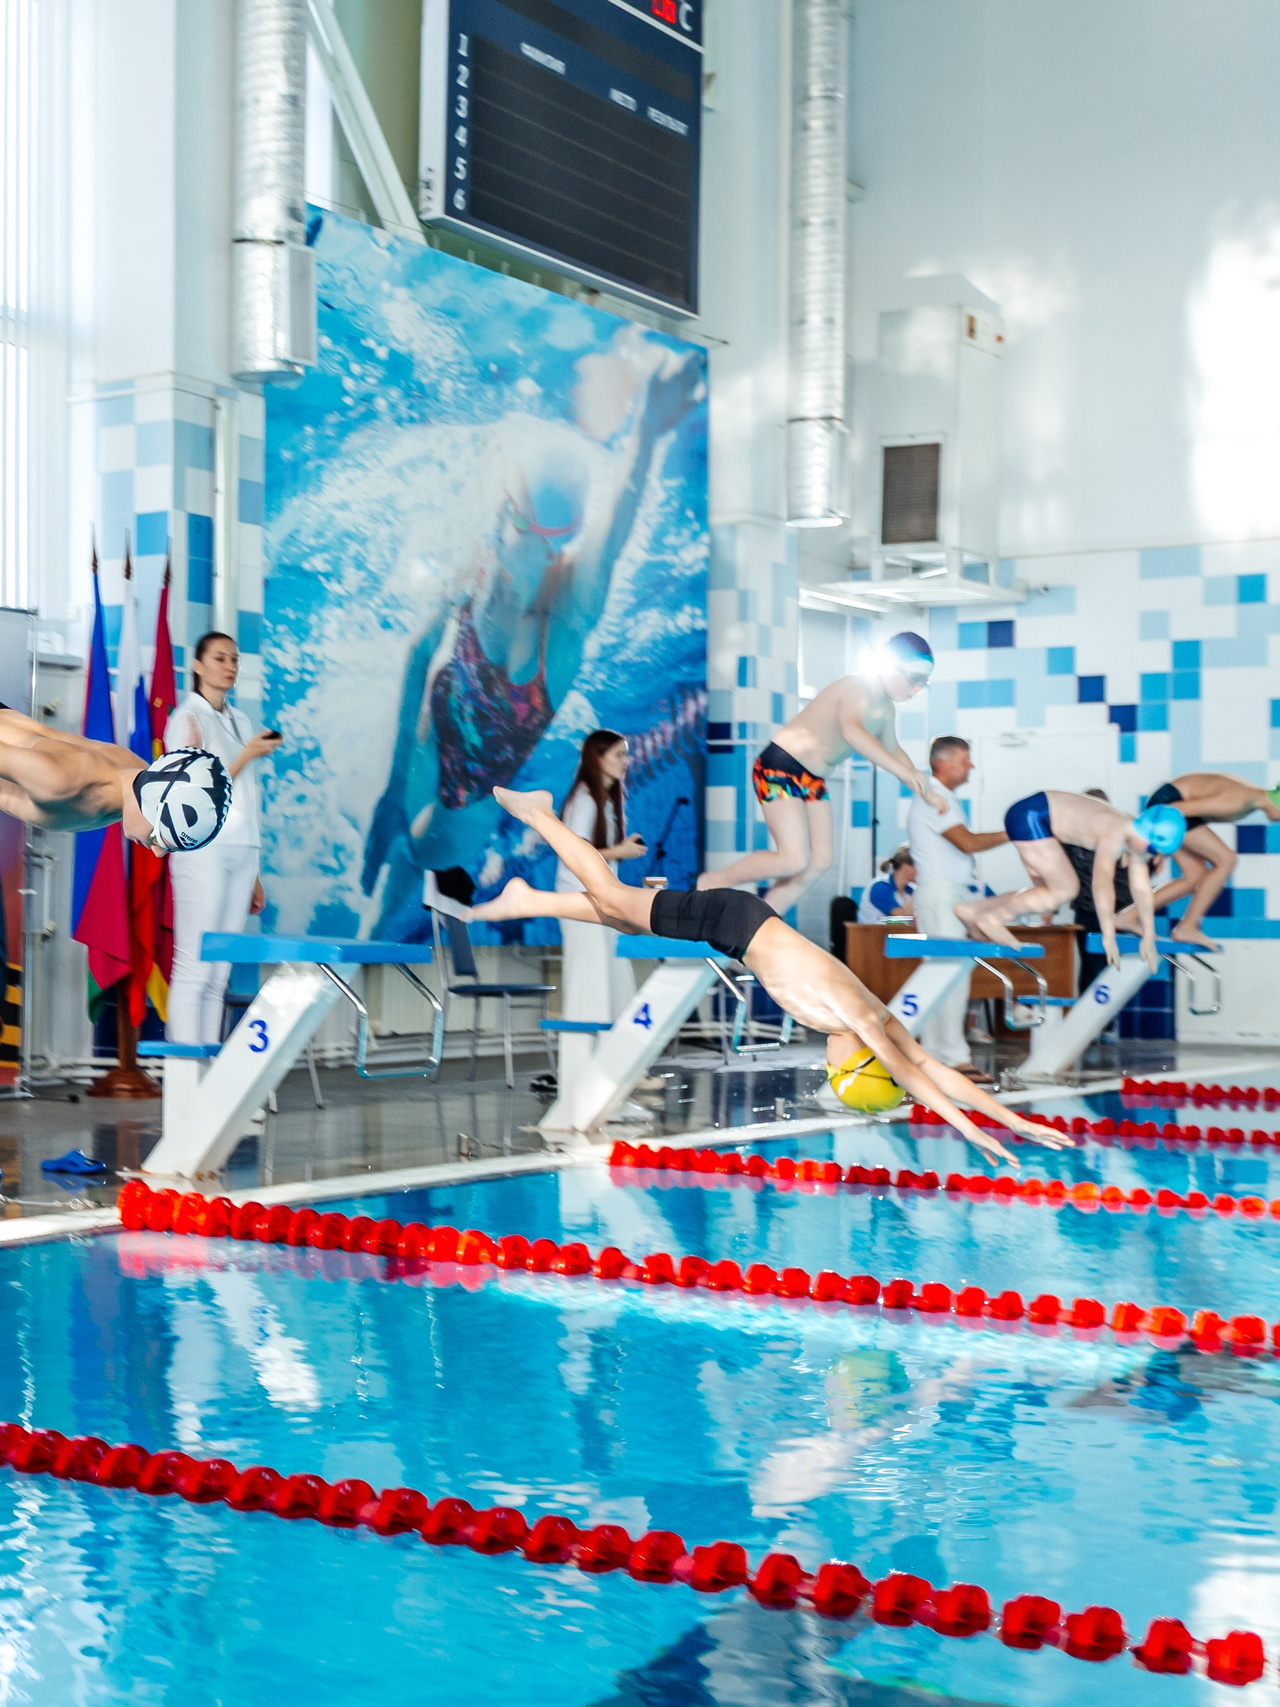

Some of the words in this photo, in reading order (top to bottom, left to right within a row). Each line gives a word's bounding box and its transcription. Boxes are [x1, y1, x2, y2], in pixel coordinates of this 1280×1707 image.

[457, 33, 468, 57] 1
[456, 64, 469, 88] 2
[455, 94, 468, 118] 3
[454, 125, 468, 148] 4
[454, 157, 467, 180] 5
[453, 188, 466, 210] 6
[902, 994, 918, 1017] 5
[1094, 985, 1110, 1005] 6
[633, 1002, 652, 1030] 4
[248, 1019, 269, 1053] 3
